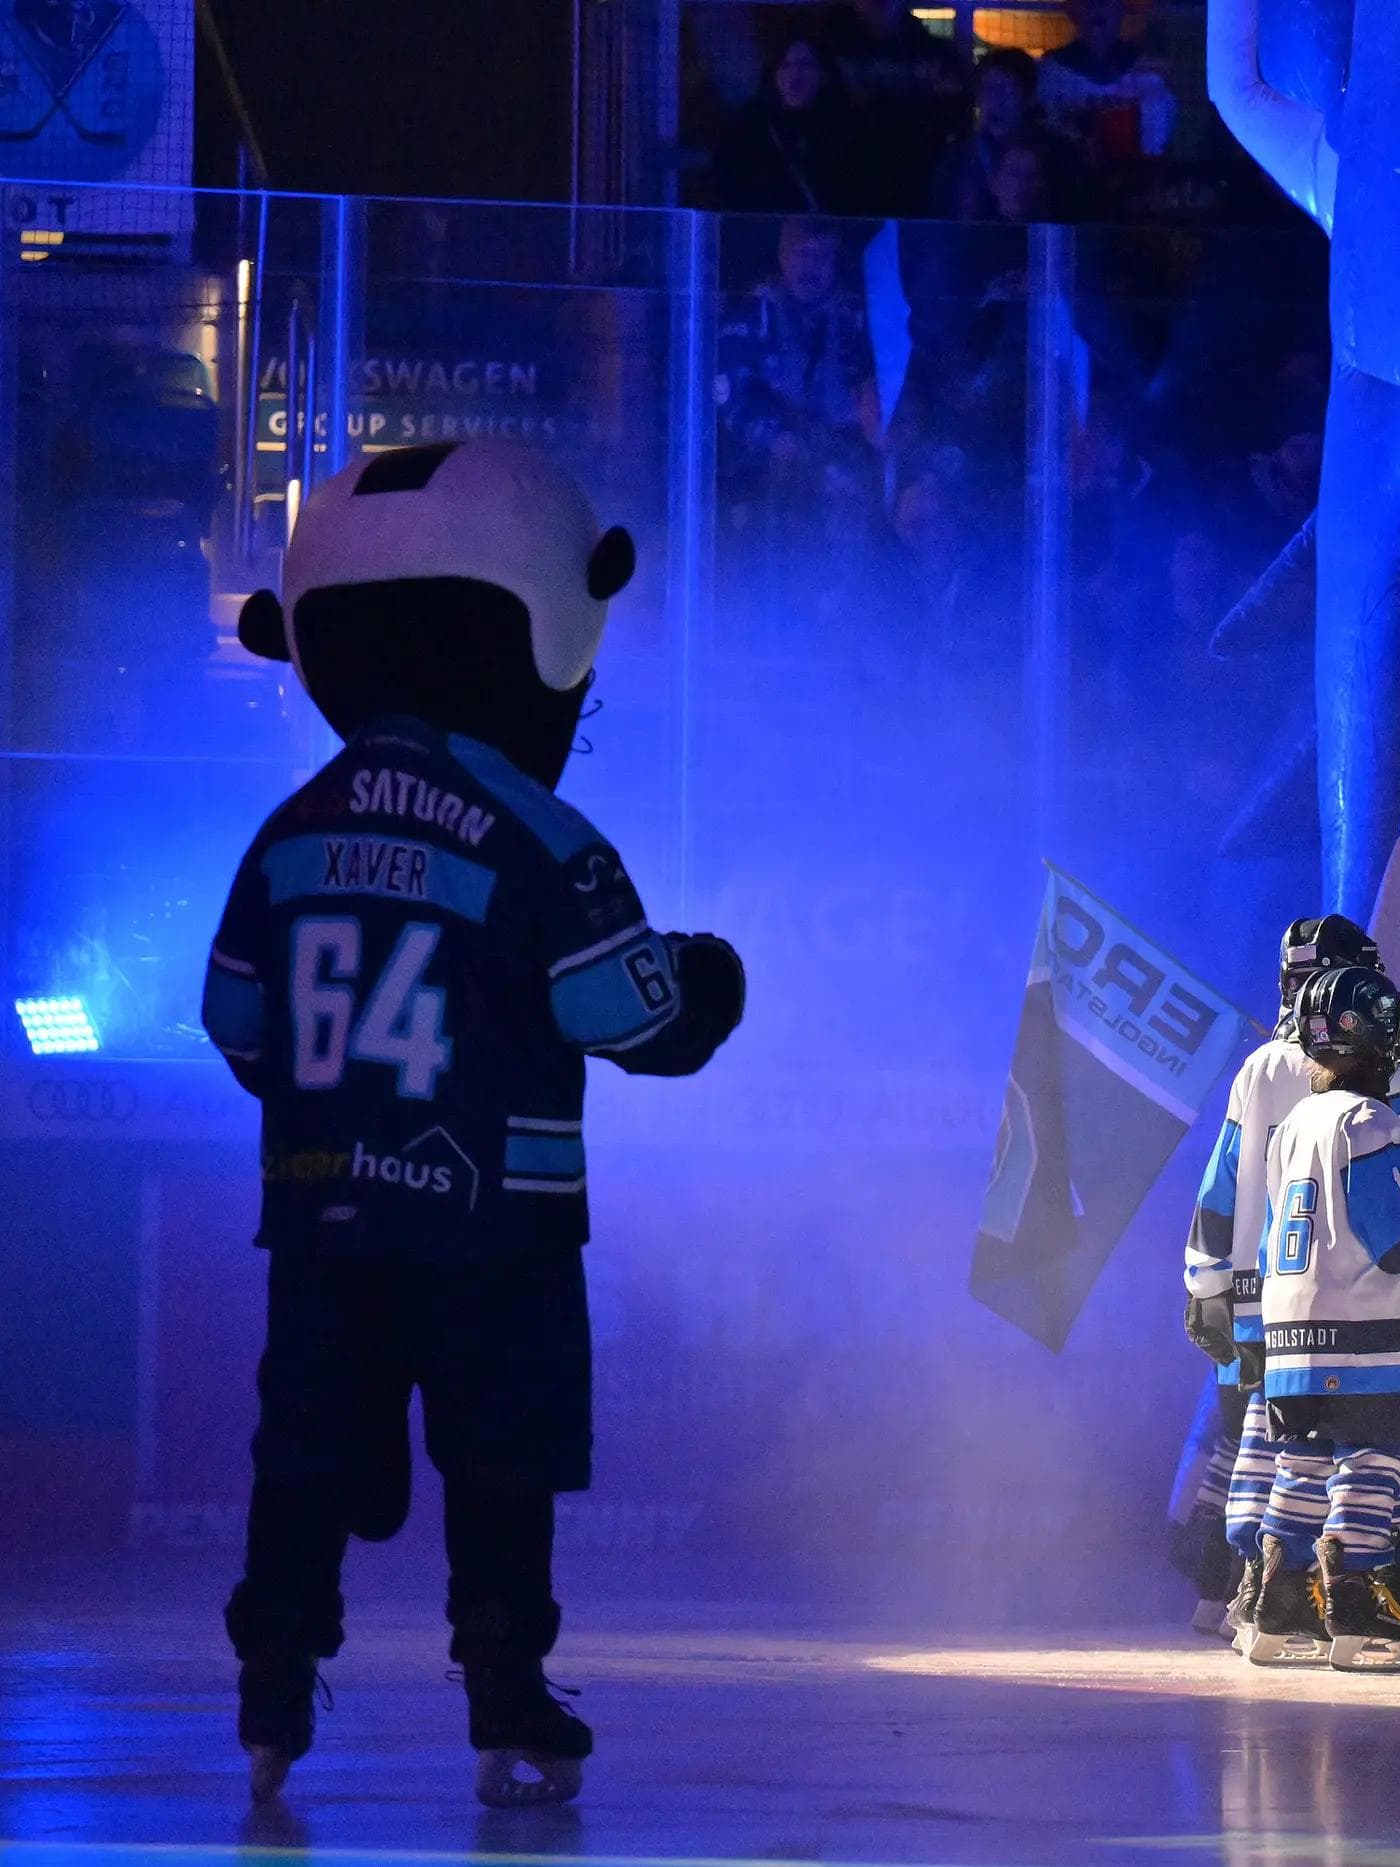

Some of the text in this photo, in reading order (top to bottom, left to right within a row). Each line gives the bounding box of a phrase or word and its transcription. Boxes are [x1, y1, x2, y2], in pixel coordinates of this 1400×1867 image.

[268, 410, 387, 438] GOUP
[349, 768, 494, 849] SATURN
[322, 837, 428, 899] XAVER
[290, 913, 453, 1101] 64
[1234, 1277, 1257, 1296] ERC
[1265, 1327, 1338, 1350] NGOLSTADT
